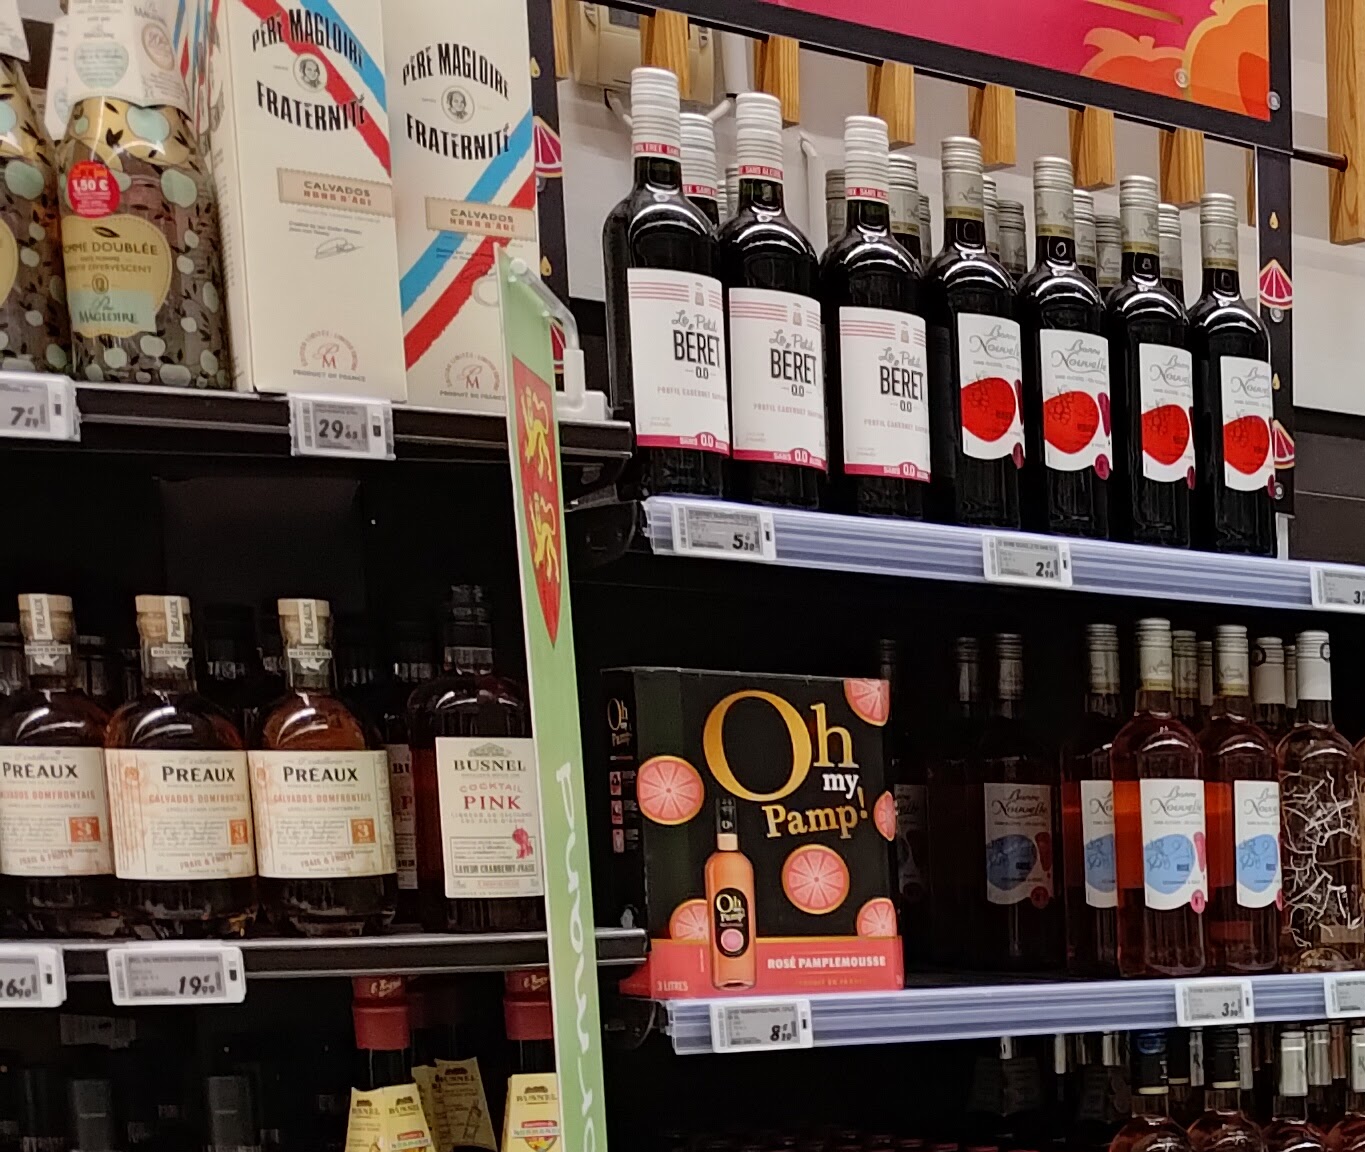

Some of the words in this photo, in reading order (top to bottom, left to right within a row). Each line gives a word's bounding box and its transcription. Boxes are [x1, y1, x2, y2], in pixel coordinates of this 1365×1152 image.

[288, 8, 364, 70] MAGLOIRE
[437, 43, 510, 101] MAGLOIRE
[256, 80, 366, 132] FRATERNITÉ
[406, 113, 510, 161] FRATERNITÉ
[303, 180, 371, 198] CALVADOS
[449, 208, 514, 224] CALVADOS
[672, 329, 721, 368] BERET
[770, 347, 817, 386] BERET
[879, 365, 924, 402] BERET
[703, 689, 860, 801] Oh
[453, 759, 527, 772] BUSNEL
[458, 782, 523, 793] COCKTAIL
[464, 796, 522, 810] PINK
[822, 770, 860, 800] my
[767, 955, 796, 970] ROSÉ
[797, 954, 887, 969] PAMPLEMOUSSE
